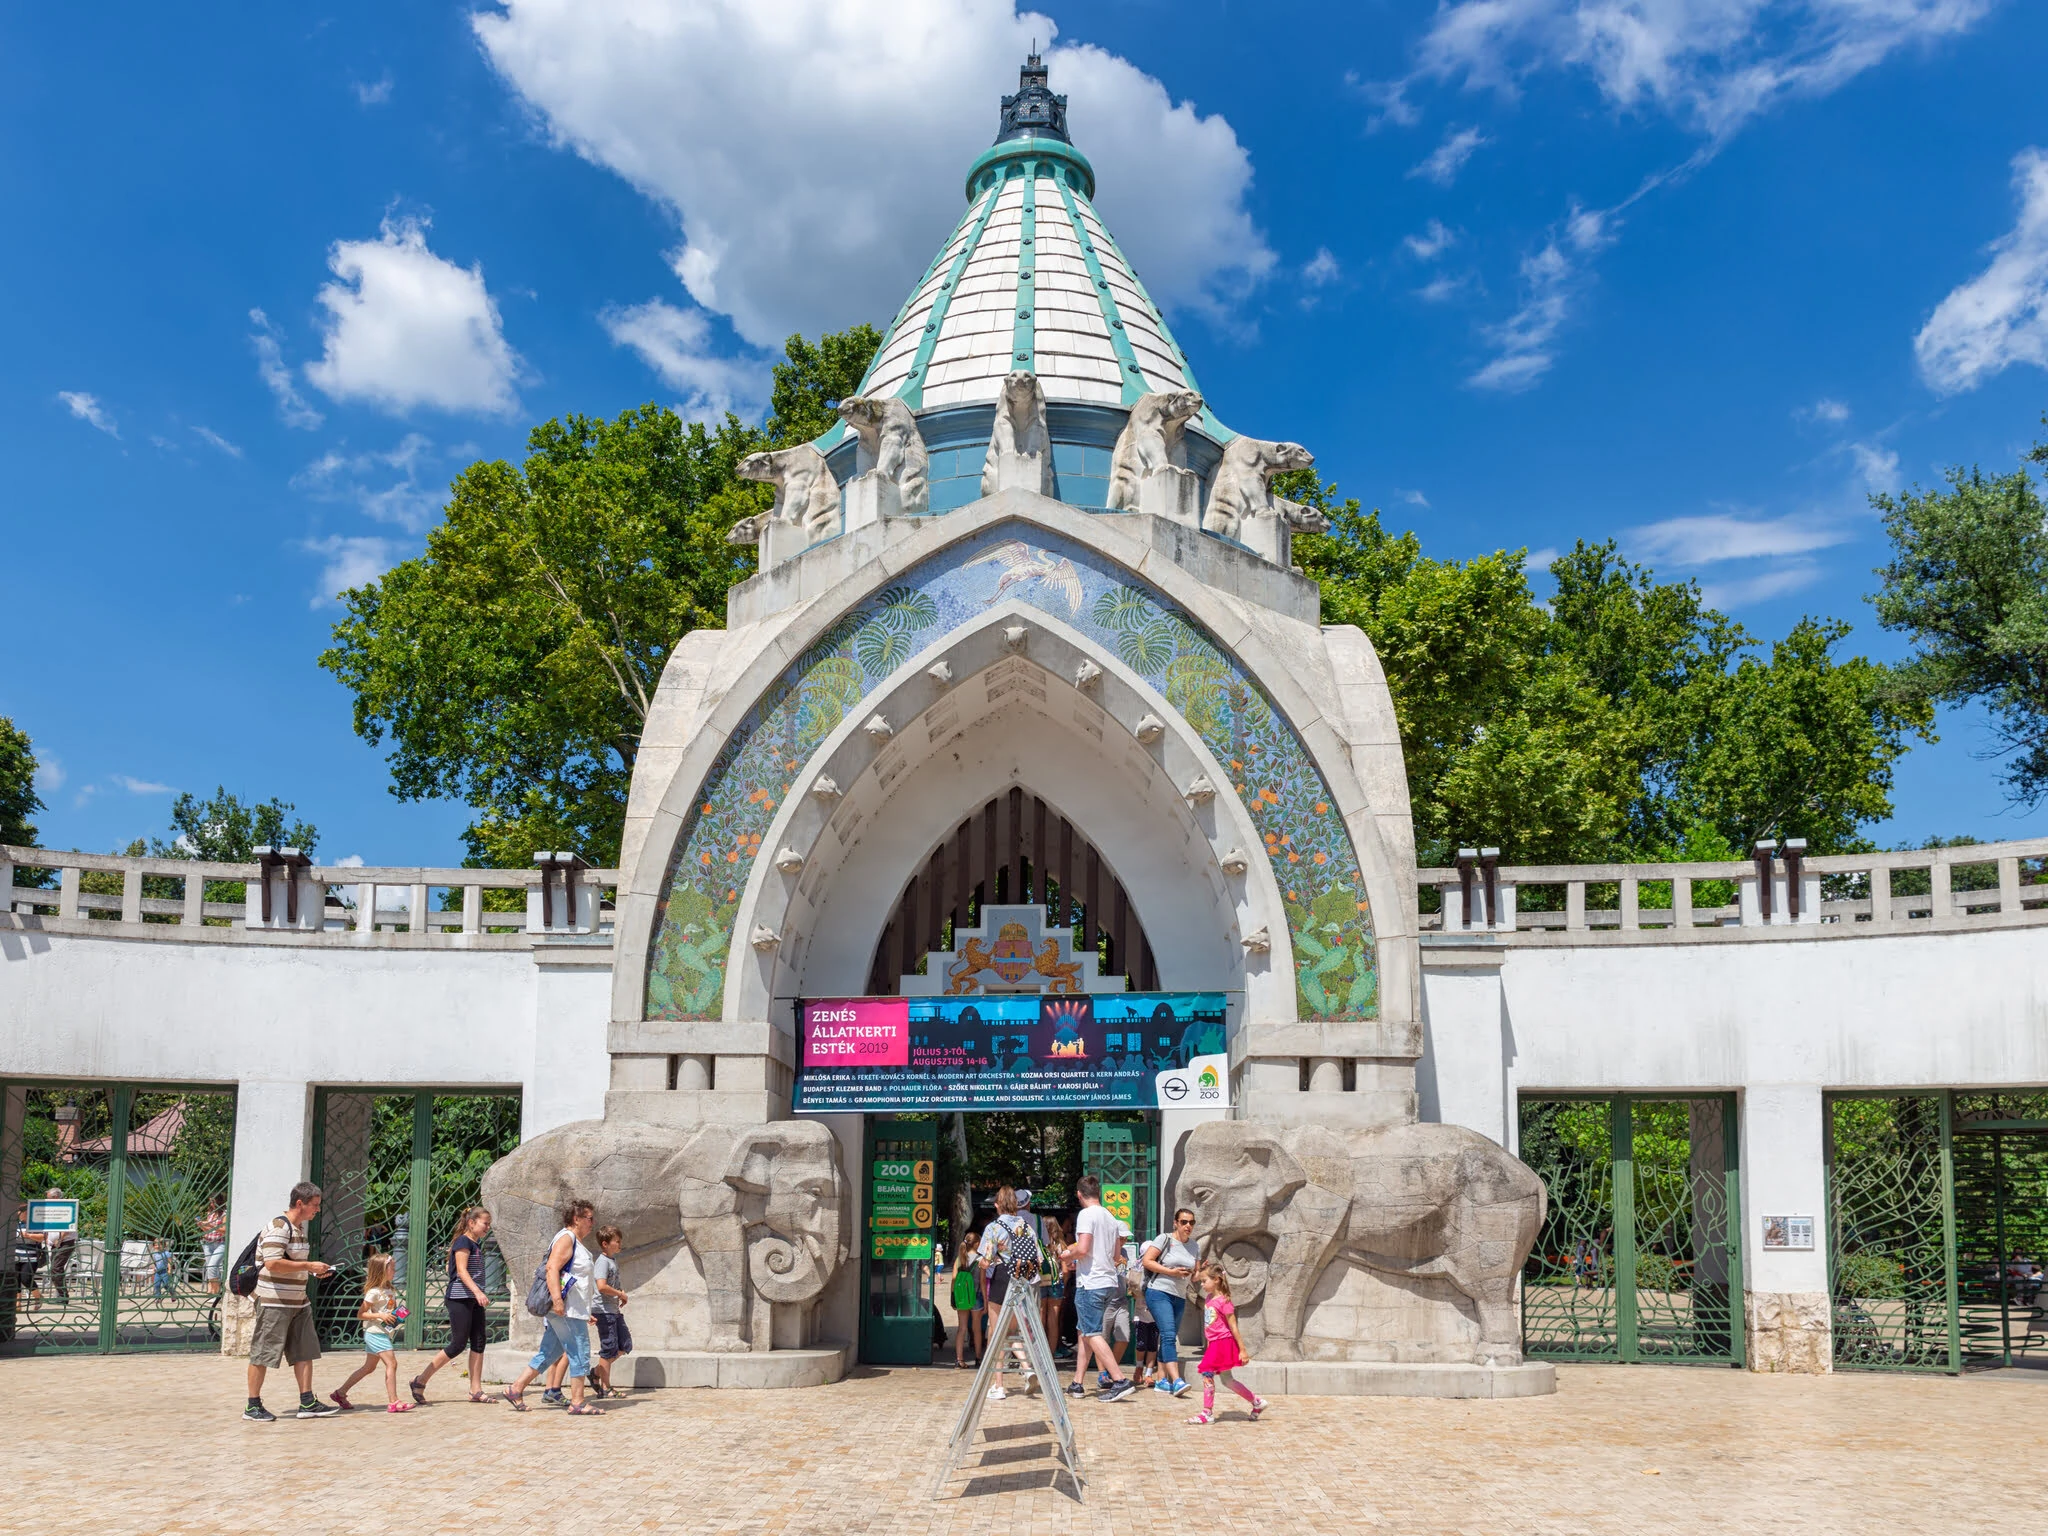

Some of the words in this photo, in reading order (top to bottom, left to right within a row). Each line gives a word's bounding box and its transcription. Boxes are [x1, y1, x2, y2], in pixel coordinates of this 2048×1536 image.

[812, 1009, 857, 1022] ZENÉS
[812, 1024, 897, 1038] ÁLLATKERTI
[812, 1040, 856, 1055] ESTÉK
[859, 1042, 889, 1054] 2019
[913, 1046, 941, 1057] JÚLIUS
[944, 1046, 968, 1056] 3-TÓL
[912, 1057, 964, 1066] AUGUSZTUS
[966, 1057, 988, 1065] 14-IG
[803, 1073, 831, 1081] MIKLÓSA
[857, 1073, 905, 1081] FEKETE-KOVÁCS
[906, 1072, 930, 1080] KORNÉL
[1061, 1071, 1089, 1079] QUARTET
[1010, 1083, 1029, 1091] GÁJER
[1029, 1082, 1052, 1090] BÁLINT
[1082, 1081, 1099, 1090] JÚLIA
[803, 1096, 825, 1104] BÉNYEI
[1051, 1093, 1090, 1101] KARÁCSONY
[1090, 1093, 1111, 1101] JÁNOS
[1111, 1093, 1132, 1101] JAMES
[1199, 1091, 1220, 1100] ZOO
[881, 1164, 910, 1176] ZOO
